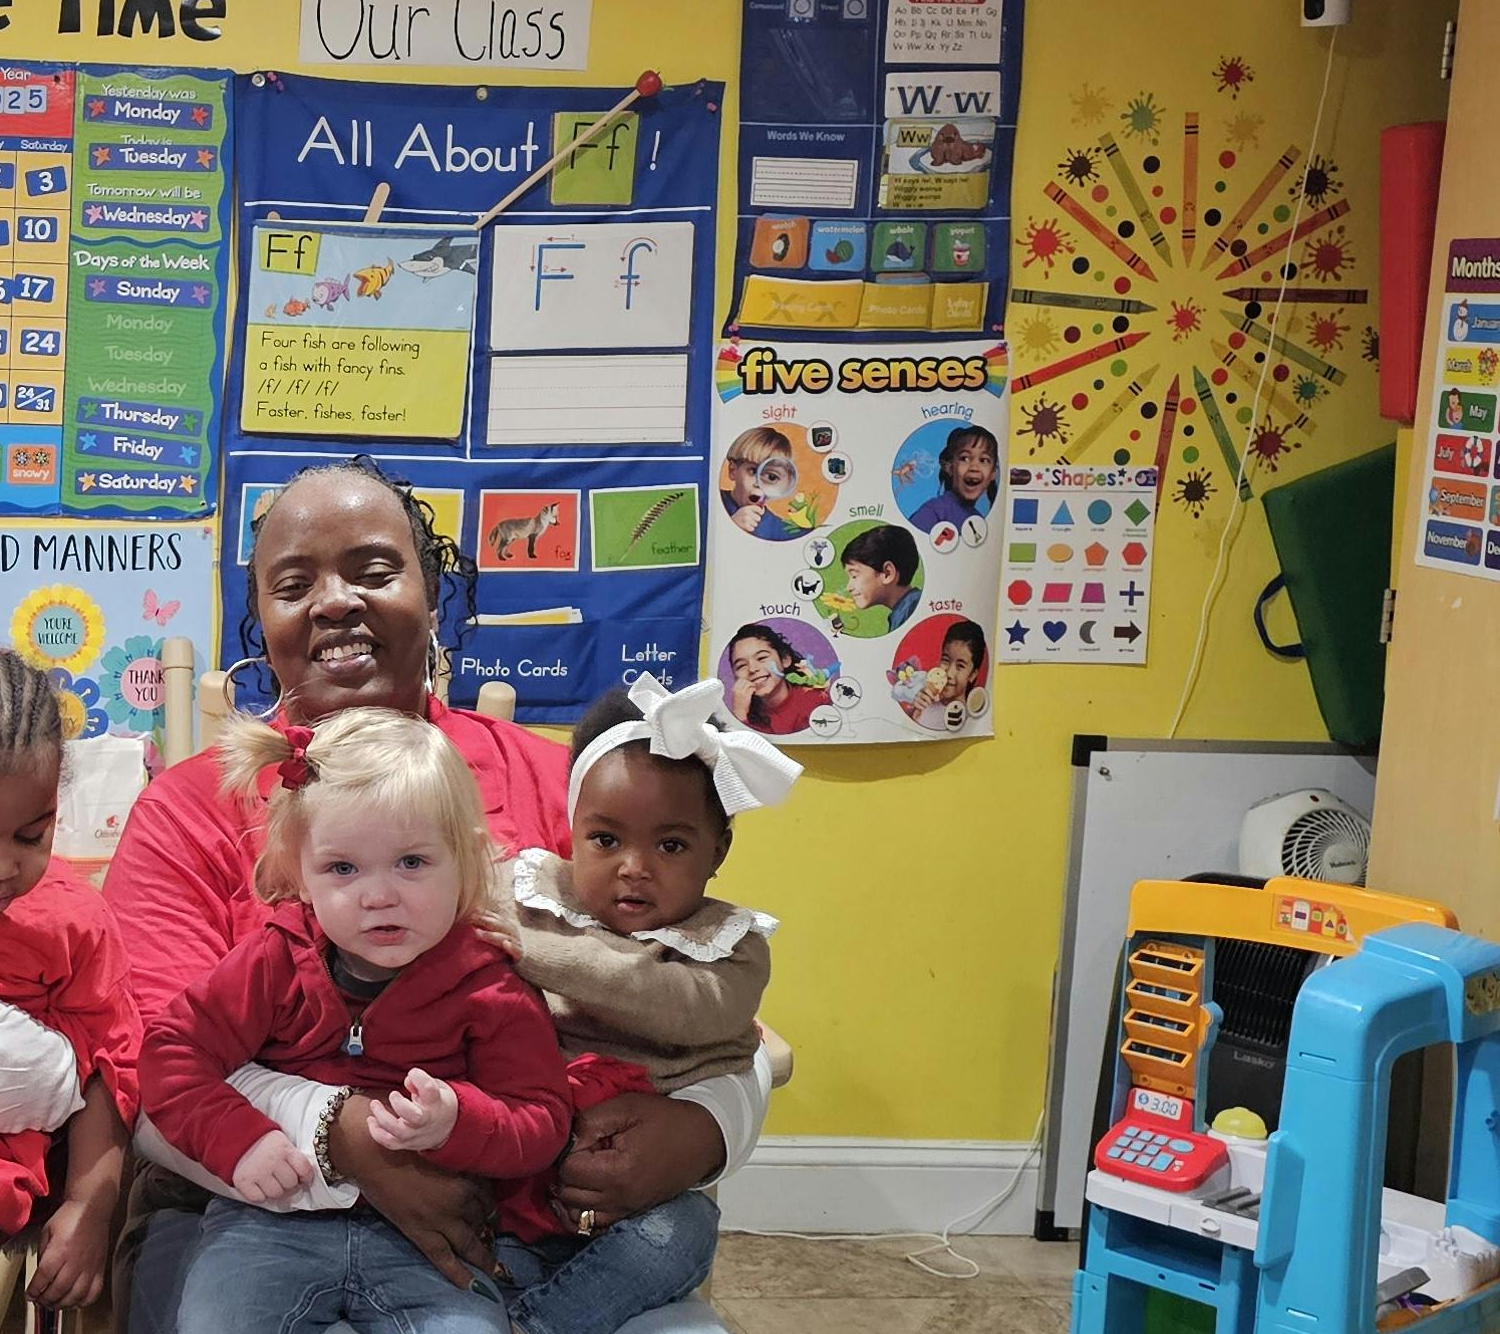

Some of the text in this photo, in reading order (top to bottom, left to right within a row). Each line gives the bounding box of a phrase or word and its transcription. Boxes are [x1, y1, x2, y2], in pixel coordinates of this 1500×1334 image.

[0, 67, 31, 82] Year
[101, 83, 197, 101] Yesterday was
[114, 100, 181, 124] Monday
[297, 116, 661, 173] All About Ff !
[767, 130, 845, 142] Words We Know
[900, 131, 930, 145] Ww
[20, 139, 68, 153] Saturday
[119, 147, 187, 169] Tuesday
[86, 183, 201, 199] Tomorrow will be
[102, 204, 192, 229] Wednesday
[23, 218, 51, 240] 10
[817, 224, 865, 235] watermelon
[266, 234, 313, 269] Ff
[73, 250, 210, 273] Days of the Week
[116, 281, 181, 304] Sunday
[261, 331, 420, 360] Four fish are following
[259, 355, 406, 381] a fish with fancy fins.
[740, 349, 986, 393] five senses
[257, 378, 340, 396] /f/ /f/ /f/
[101, 403, 180, 428] Thursday
[361, 404, 406, 422] faster!
[761, 405, 797, 420] sight
[920, 401, 974, 420] hearing
[1469, 404, 1488, 422] May
[112, 436, 164, 461] Friday
[12, 468, 50, 480] snowy
[98, 472, 177, 495] Saturday
[1051, 467, 1116, 490] Shapes
[1440, 490, 1485, 508] September
[849, 504, 885, 518] smell
[1426, 531, 1469, 551] November
[32, 532, 183, 573] MANNERS
[759, 603, 801, 617] touch
[928, 598, 963, 613] taste
[37, 632, 79, 646] WELCOME
[621, 643, 677, 662] Letter
[460, 656, 569, 678] Photo Cards
[128, 669, 166, 685] THANK
[134, 686, 159, 702] YOU
